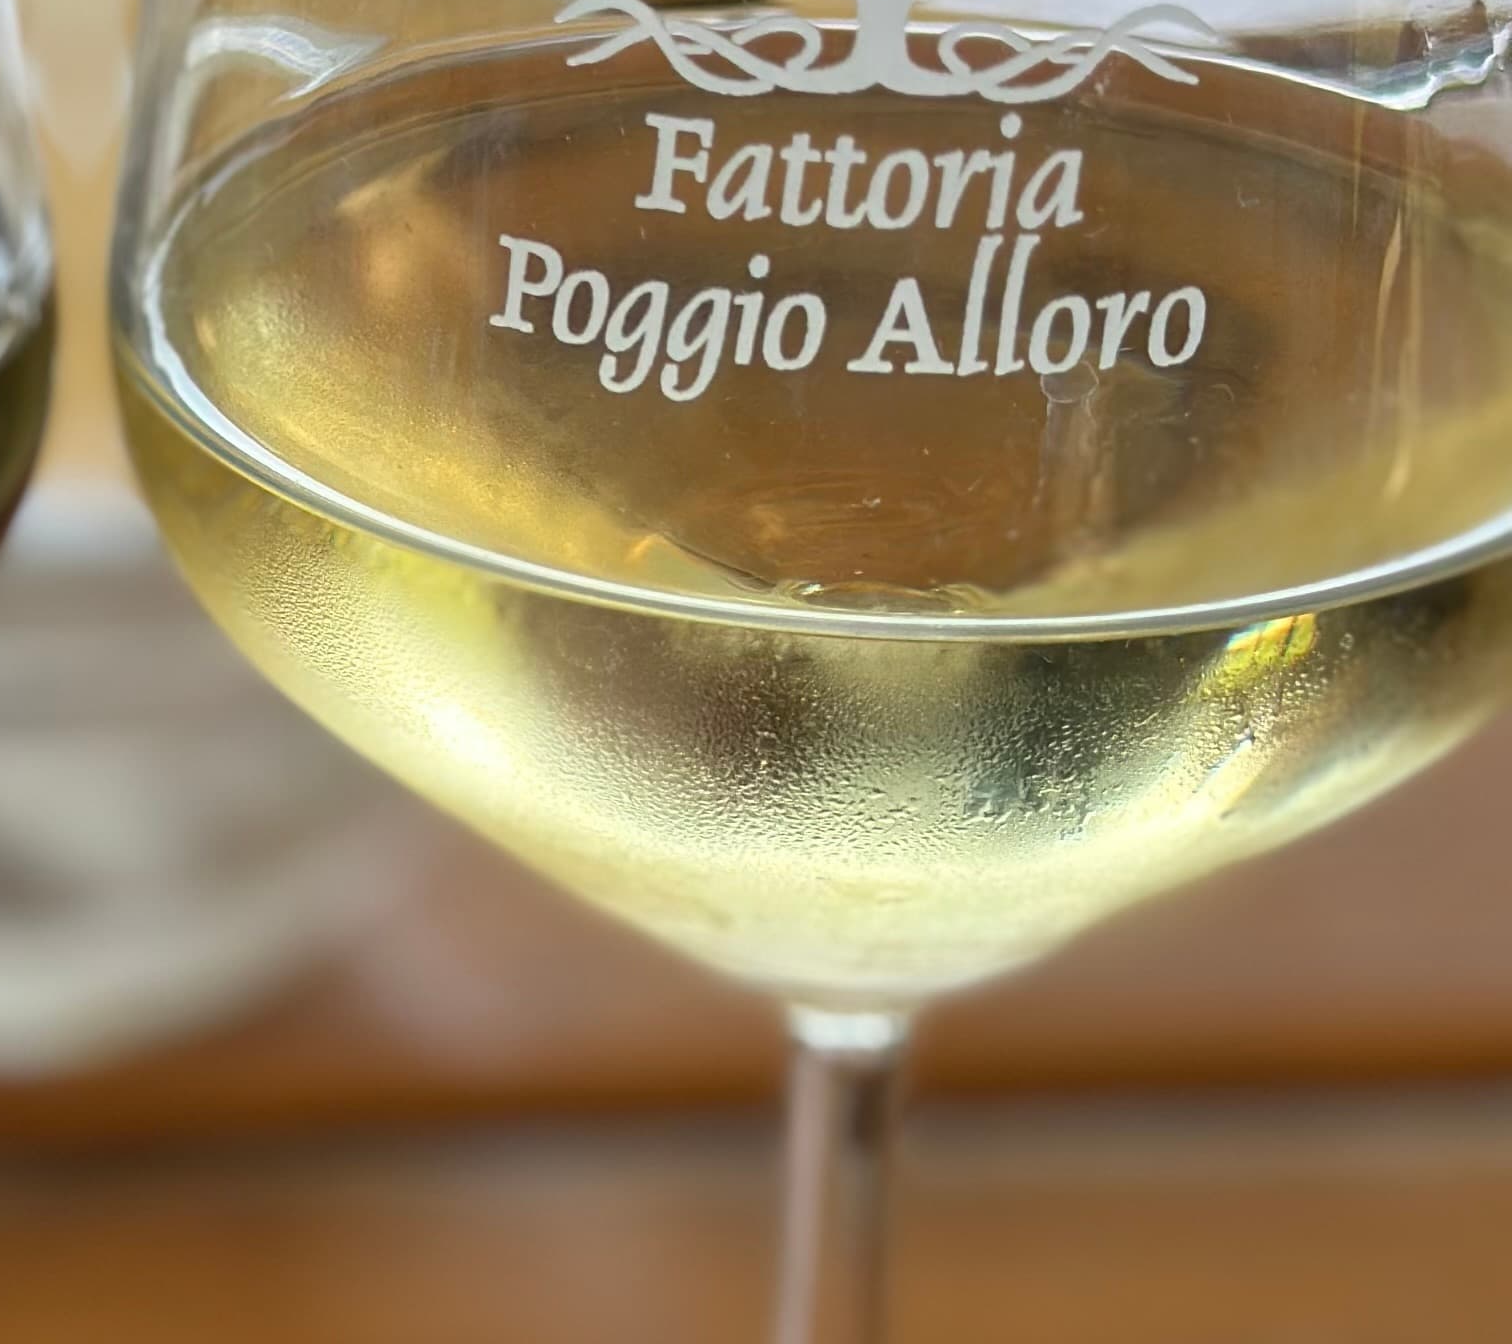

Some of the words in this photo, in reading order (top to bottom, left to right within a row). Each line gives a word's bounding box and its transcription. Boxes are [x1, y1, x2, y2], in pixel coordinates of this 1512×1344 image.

[635, 112, 1085, 230] Fattoria
[489, 233, 828, 403] Poggio
[846, 233, 1207, 378] Alloro
